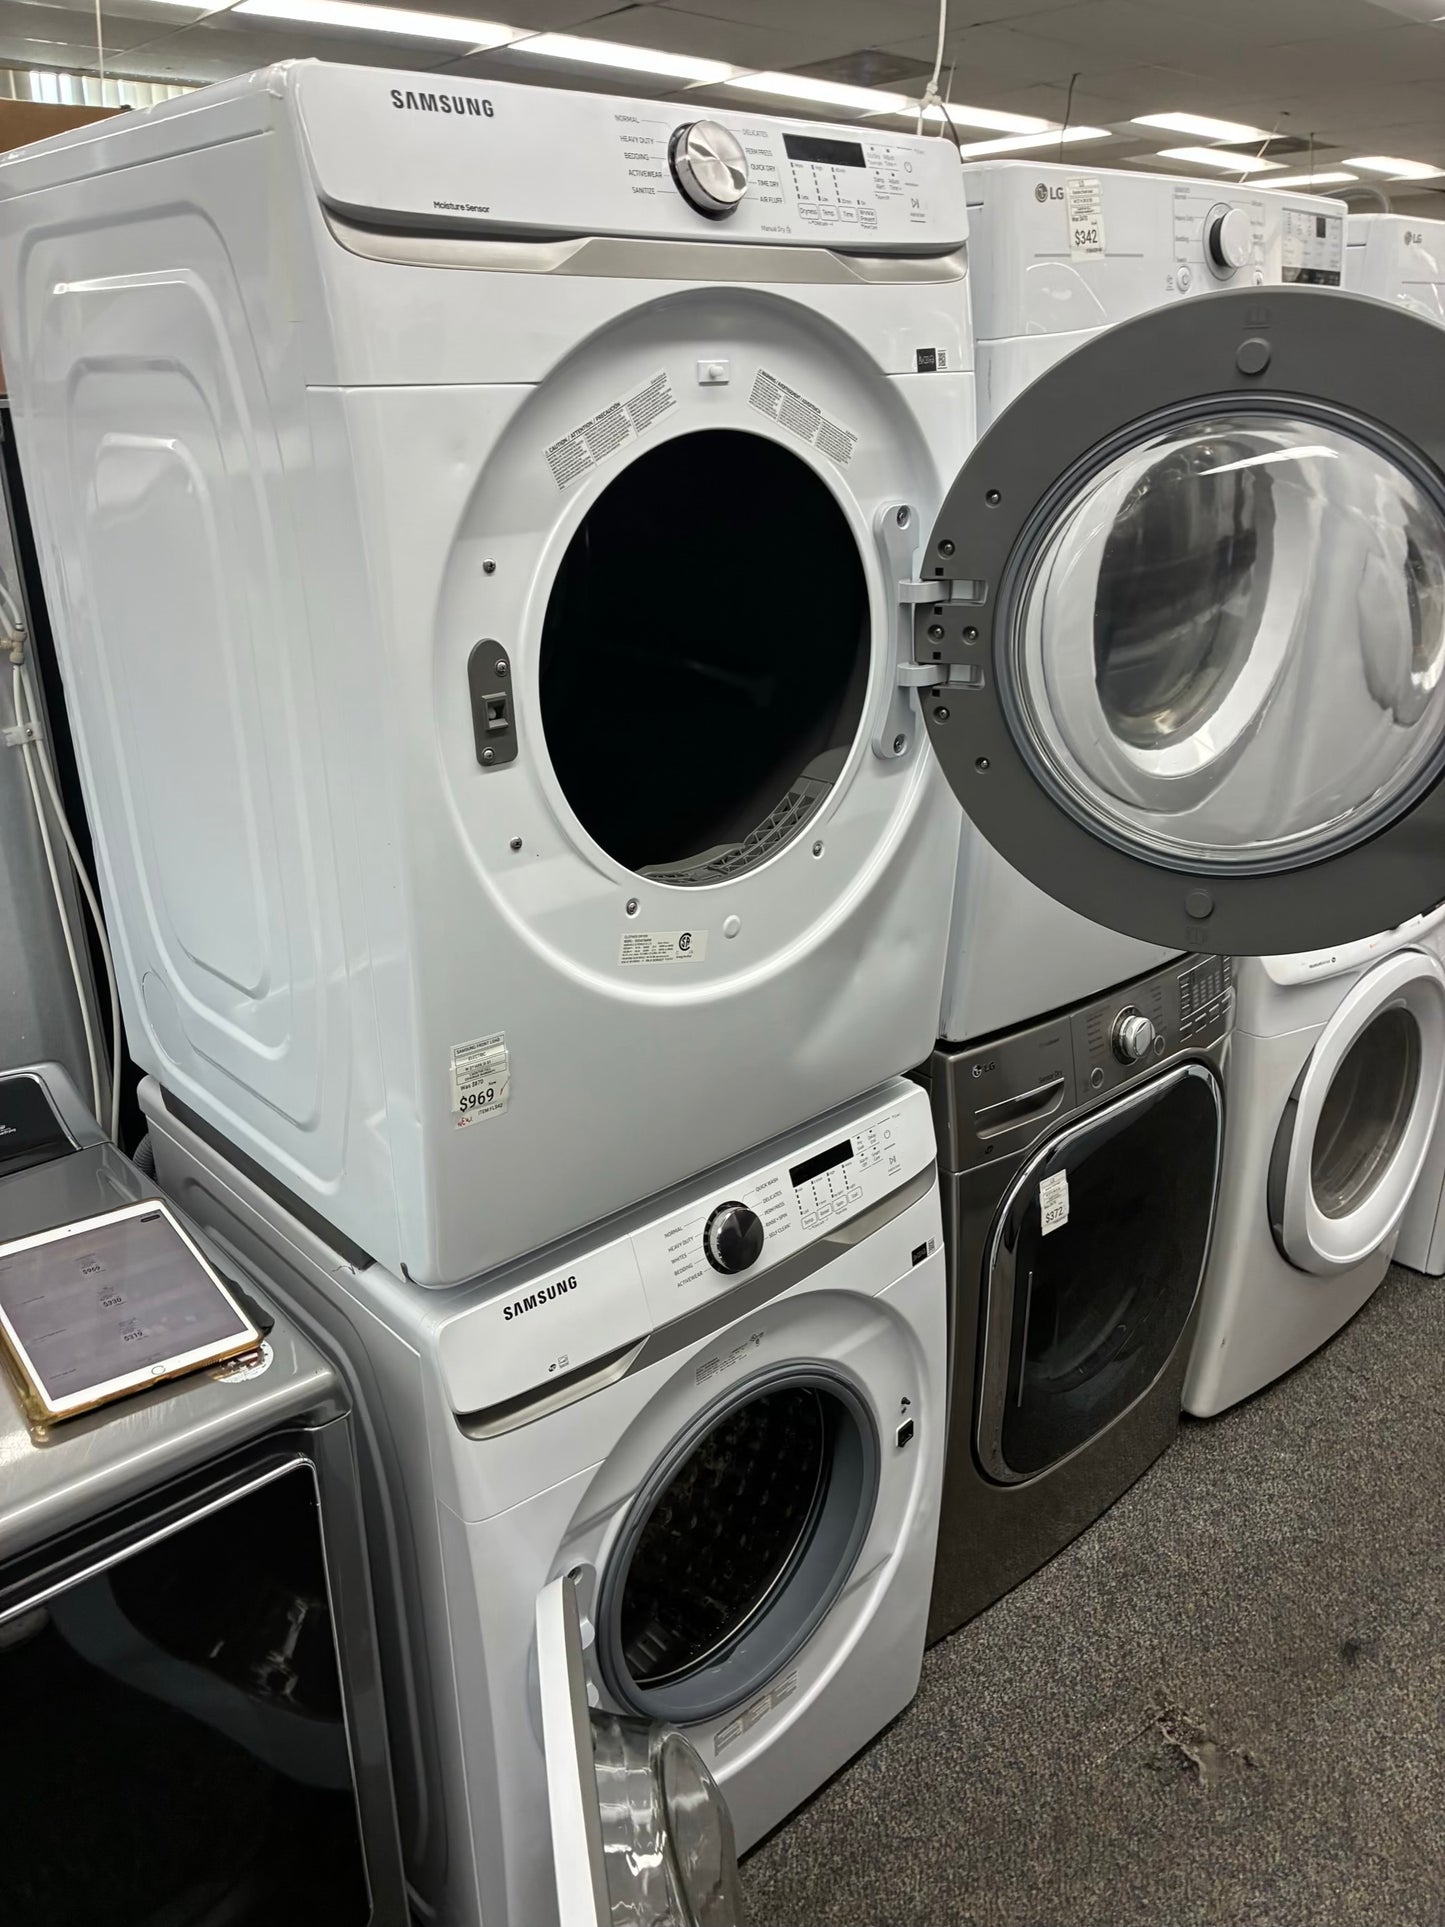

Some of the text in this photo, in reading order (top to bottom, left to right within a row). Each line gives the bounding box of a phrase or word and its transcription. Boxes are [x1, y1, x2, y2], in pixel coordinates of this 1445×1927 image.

[390, 89, 494, 118] SAMSUNG
[614, 114, 640, 123] NORMAL
[619, 135, 638, 143] HEAVY
[742, 128, 768, 138] DELICATES
[624, 152, 650, 160] BEDDING
[628, 169, 663, 178] ACTIVEWEAR
[750, 163, 764, 172] QUICK
[631, 186, 656, 195] SANITIZE
[1050, 186, 1065, 200] LG
[433, 201, 490, 213] Moisture Sensor
[770, 197, 783, 205] FLUFF
[1074, 228, 1098, 247] $342
[548, 437, 568, 454] CAUTION
[570, 420, 594, 439] ATTENTION
[460, 1087, 494, 1113] $969
[756, 1184, 768, 1192] QUICK
[762, 1190, 782, 1204] DELICATES
[1046, 1206, 1063, 1224] $372
[664, 1226, 683, 1239] NORMAL
[668, 1236, 694, 1252] HEAVY DUTY
[670, 1253, 687, 1264] WHITES
[674, 1263, 694, 1276] BEDDING
[677, 1270, 704, 1288] ACTIVEWEAR
[503, 1276, 578, 1320] SAMSUNG
